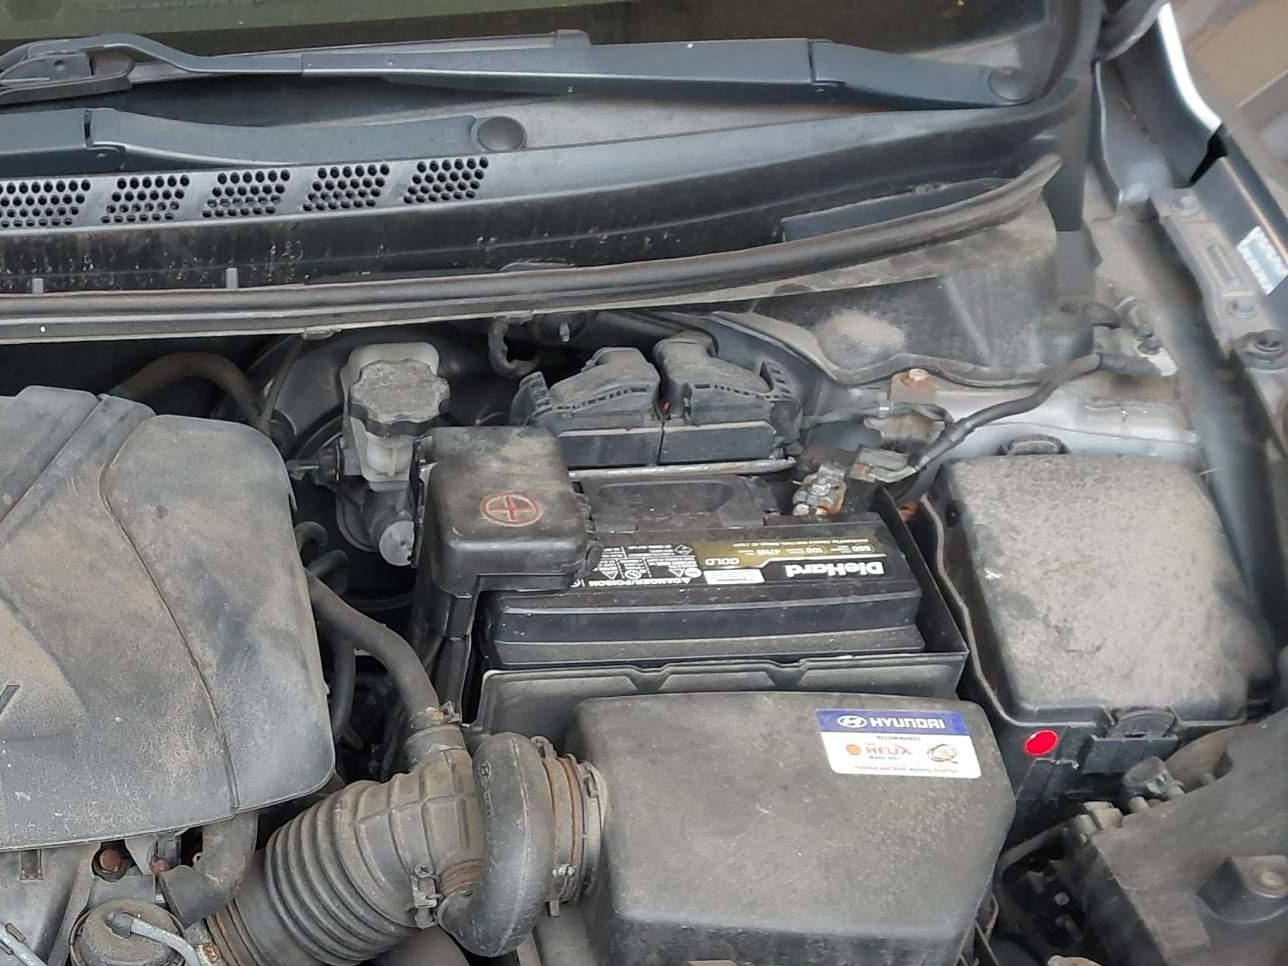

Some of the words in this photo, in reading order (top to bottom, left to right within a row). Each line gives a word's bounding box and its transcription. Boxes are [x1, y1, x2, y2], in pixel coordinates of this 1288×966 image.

[705, 557, 740, 566] GOLD
[785, 561, 885, 578] DieHard
[870, 716, 947, 729] HYUNDAI
